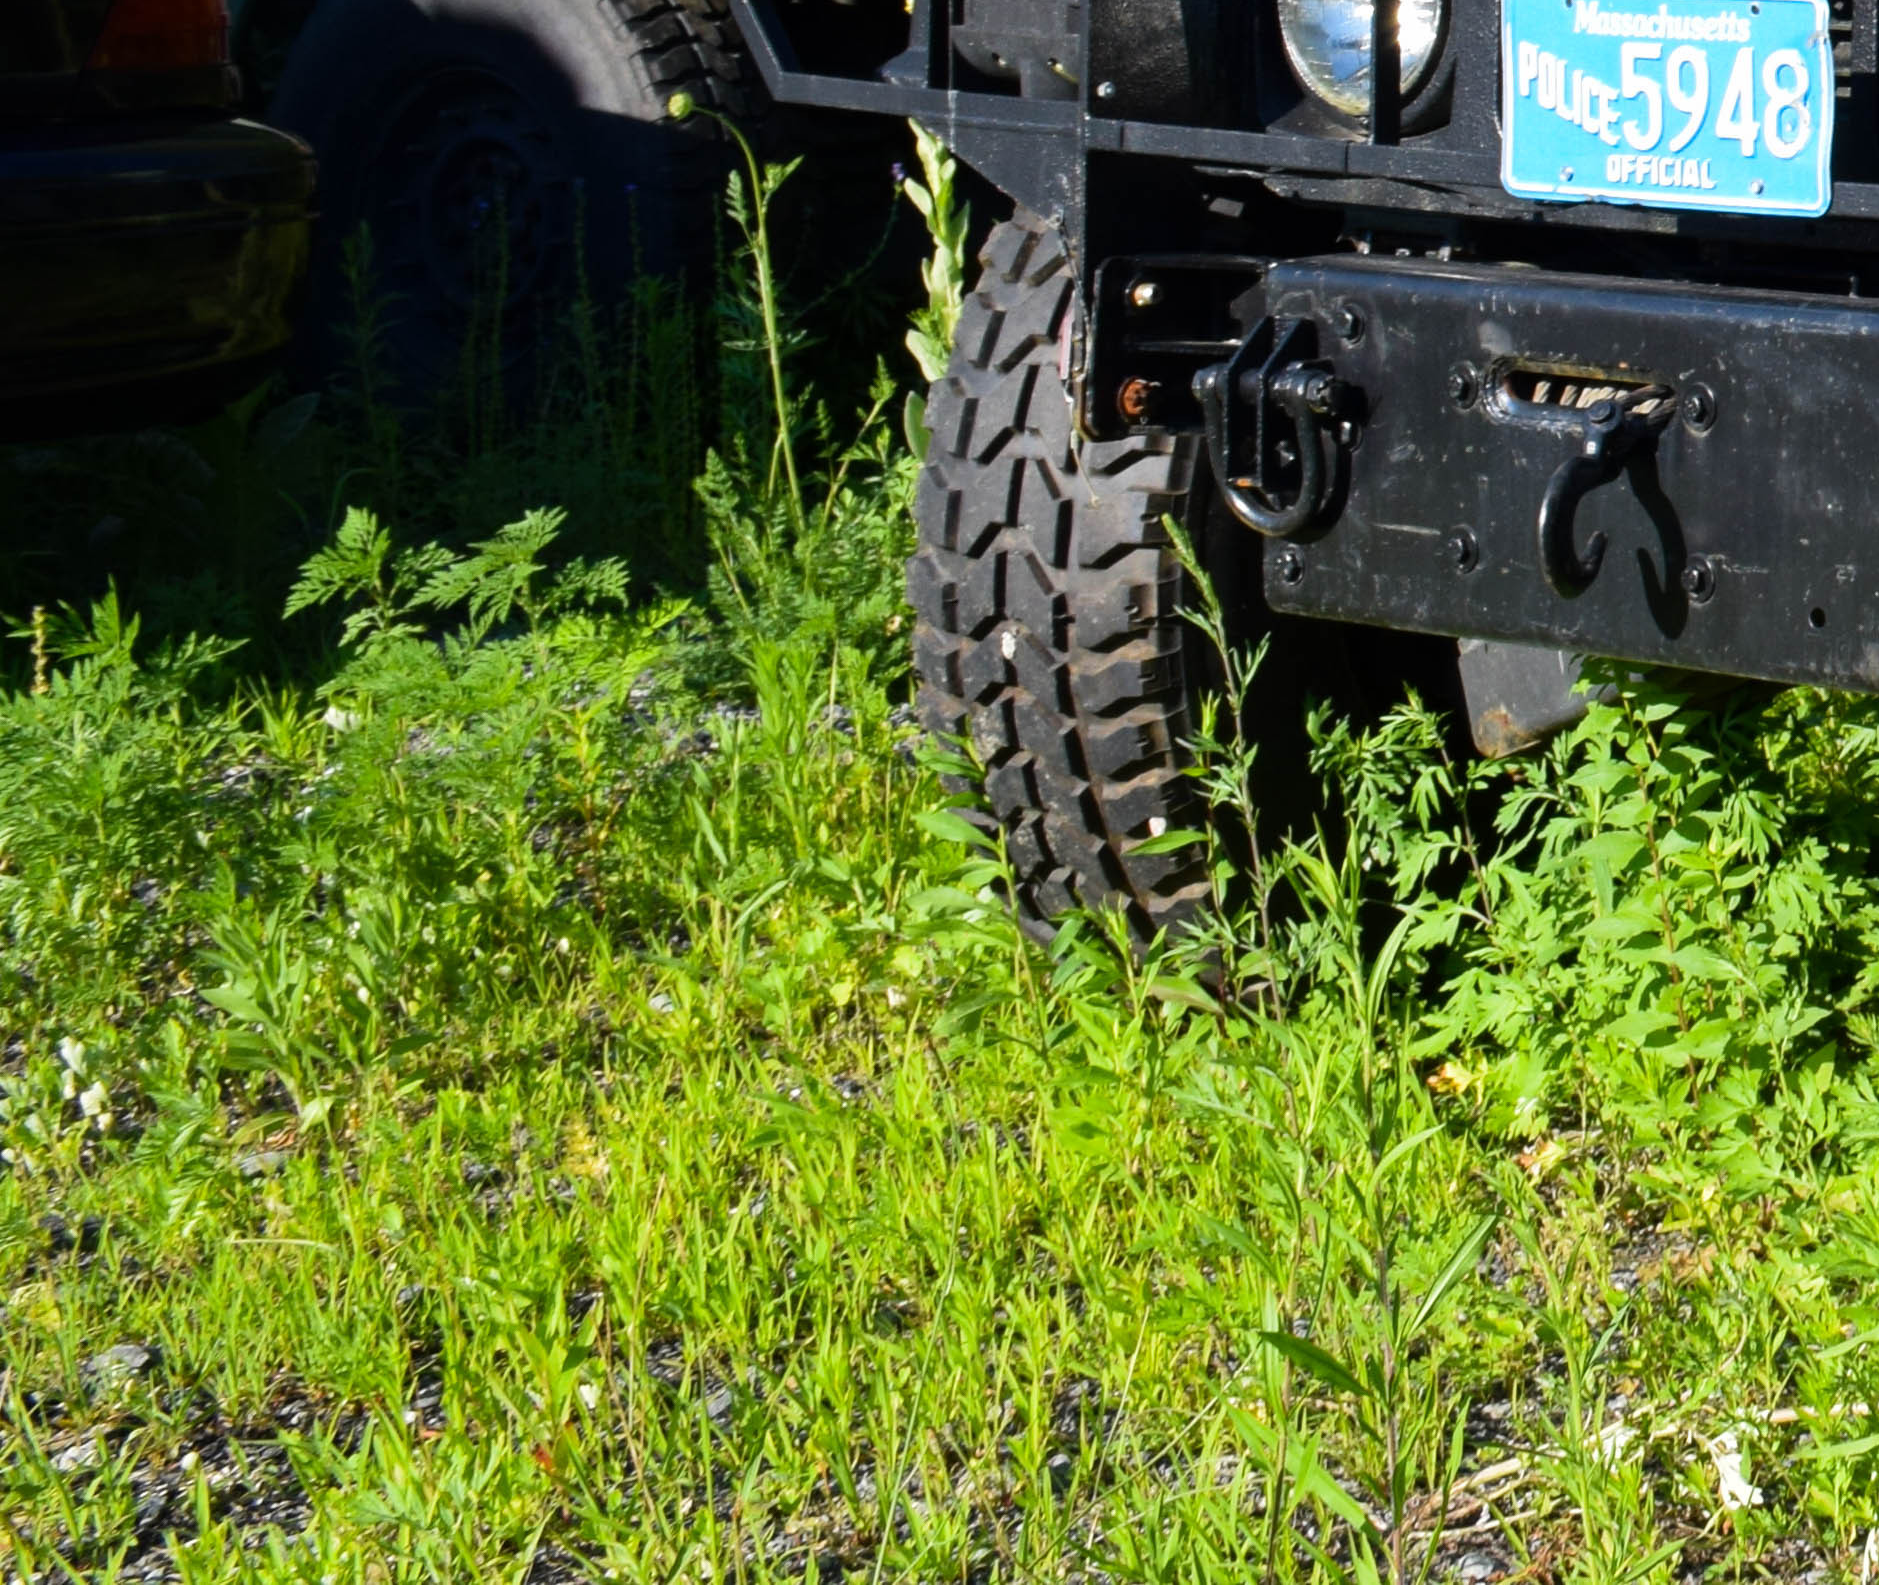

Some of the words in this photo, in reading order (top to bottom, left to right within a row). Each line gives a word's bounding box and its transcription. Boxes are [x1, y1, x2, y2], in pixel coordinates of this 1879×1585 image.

[1574, 0, 1752, 42] Massachusetts
[1519, 42, 1621, 146] POLICE
[1621, 44, 1811, 159] 5948
[1605, 154, 1718, 190] OFFICIAL
